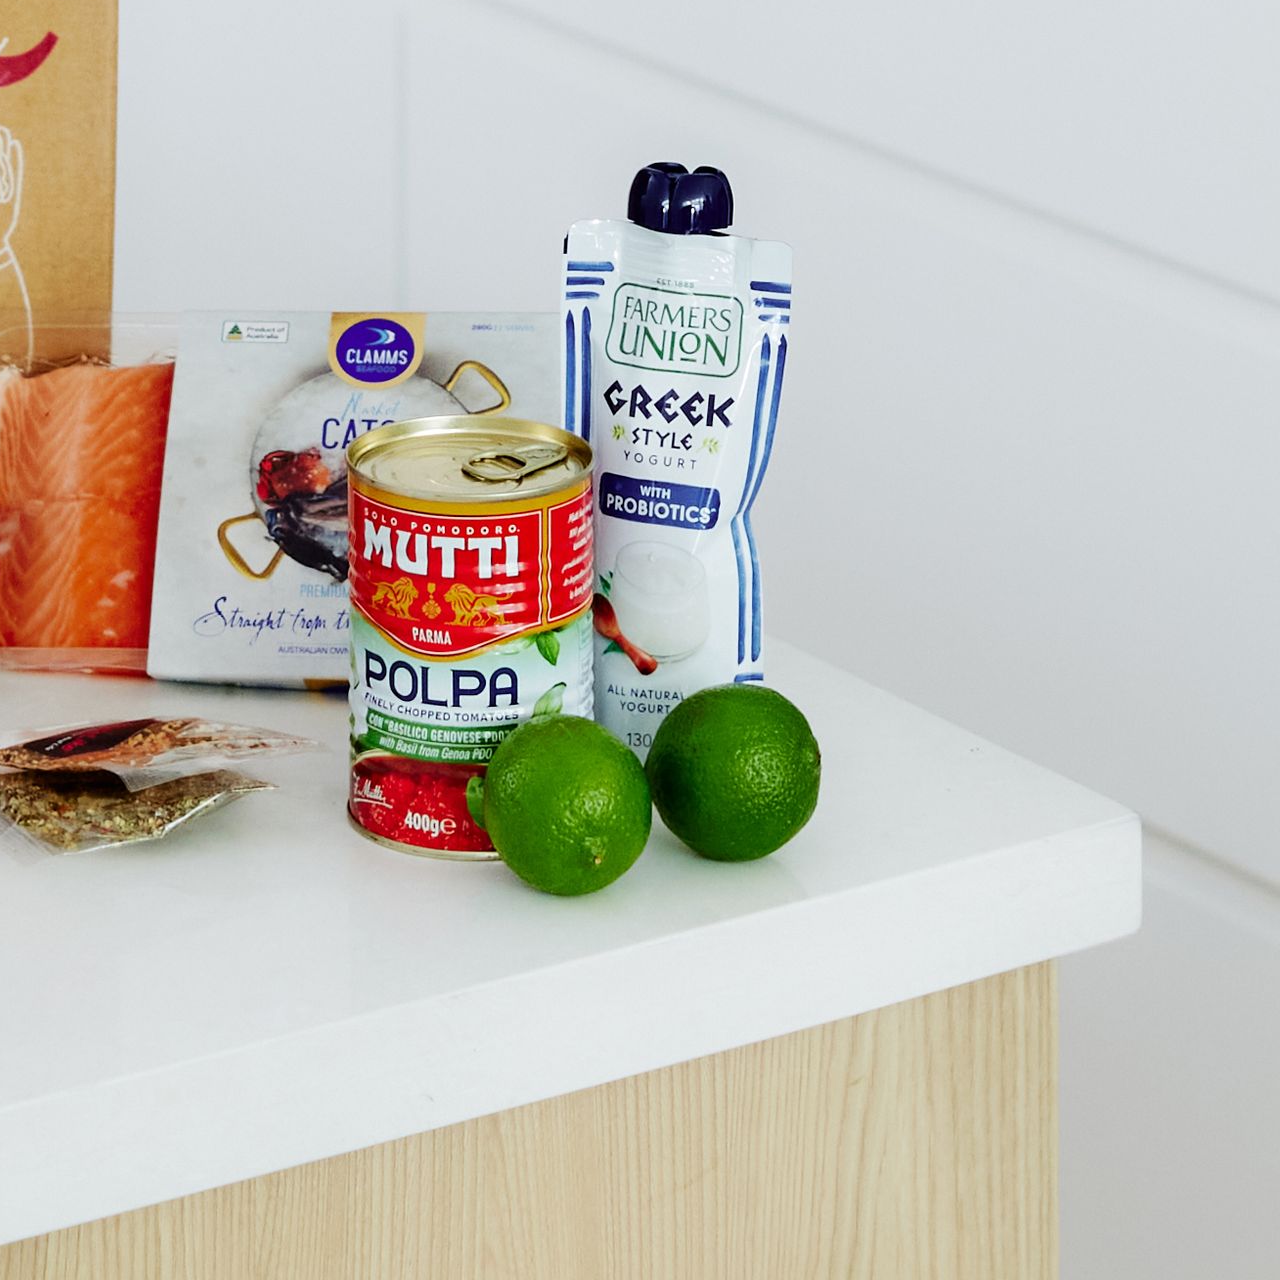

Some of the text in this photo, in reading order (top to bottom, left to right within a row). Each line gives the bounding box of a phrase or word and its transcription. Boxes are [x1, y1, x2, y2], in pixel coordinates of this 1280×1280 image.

[623, 295, 733, 332] FARMERS
[346, 348, 408, 365] CLAMMS
[619, 321, 729, 367] UNION
[603, 380, 736, 428] GREEK
[322, 418, 396, 449] CAT
[631, 427, 693, 451] STYLE
[623, 450, 697, 470] YOGURT
[639, 485, 671, 500] WITH
[364, 506, 398, 526] SOLO
[363, 518, 520, 580] MUTTI
[411, 626, 452, 646] PARMA
[278, 646, 328, 655] AUSTRALIAN
[364, 648, 520, 709] POLPA
[607, 684, 685, 701] ALL NATURAL
[364, 691, 520, 723] FINELY CHOPPED TOMATOES
[620, 701, 671, 715] YOGURT
[368, 713, 384, 729] CON
[430, 729, 482, 745] GENOVESE
[379, 735, 396, 748] with
[395, 738, 418, 755] Basil
[418, 742, 439, 759] from
[441, 748, 471, 761] Genoa
